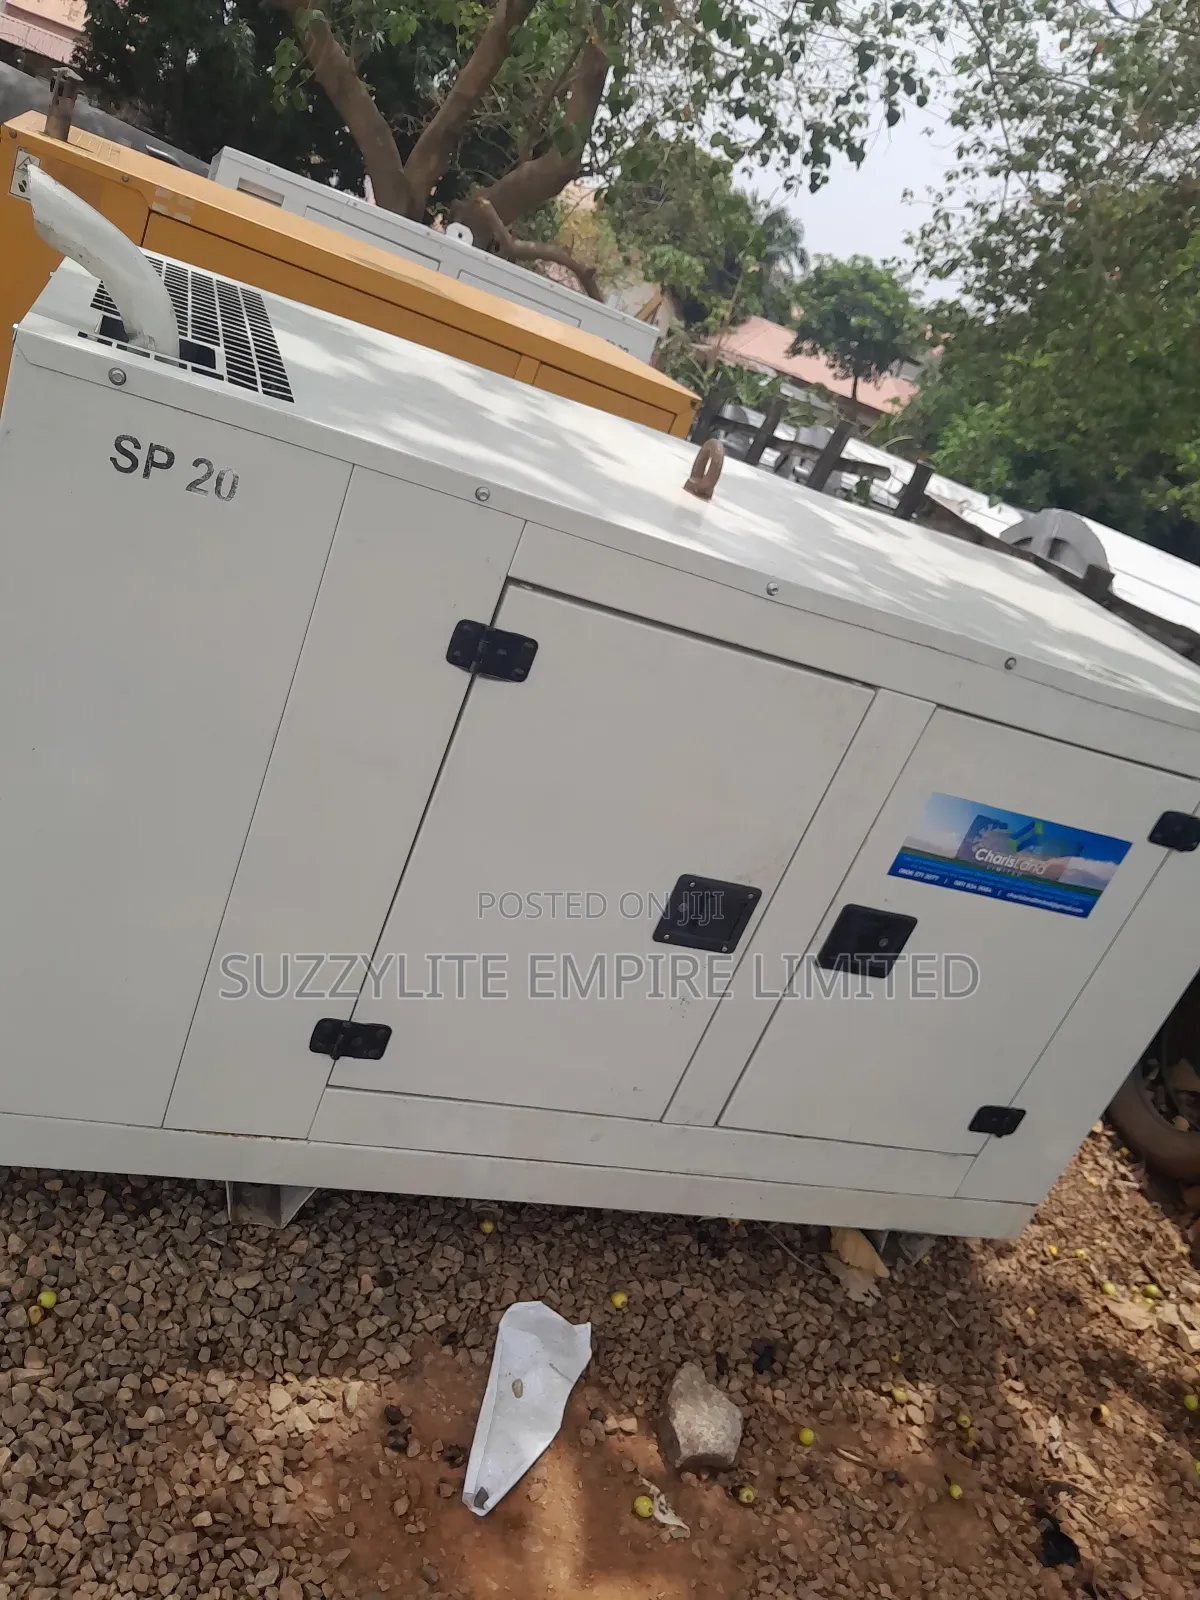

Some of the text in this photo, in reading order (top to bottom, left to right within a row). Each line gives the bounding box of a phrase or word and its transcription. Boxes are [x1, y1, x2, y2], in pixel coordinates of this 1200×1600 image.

[109, 434, 240, 502] SP 20
[974, 847, 1049, 875] CharisLand
